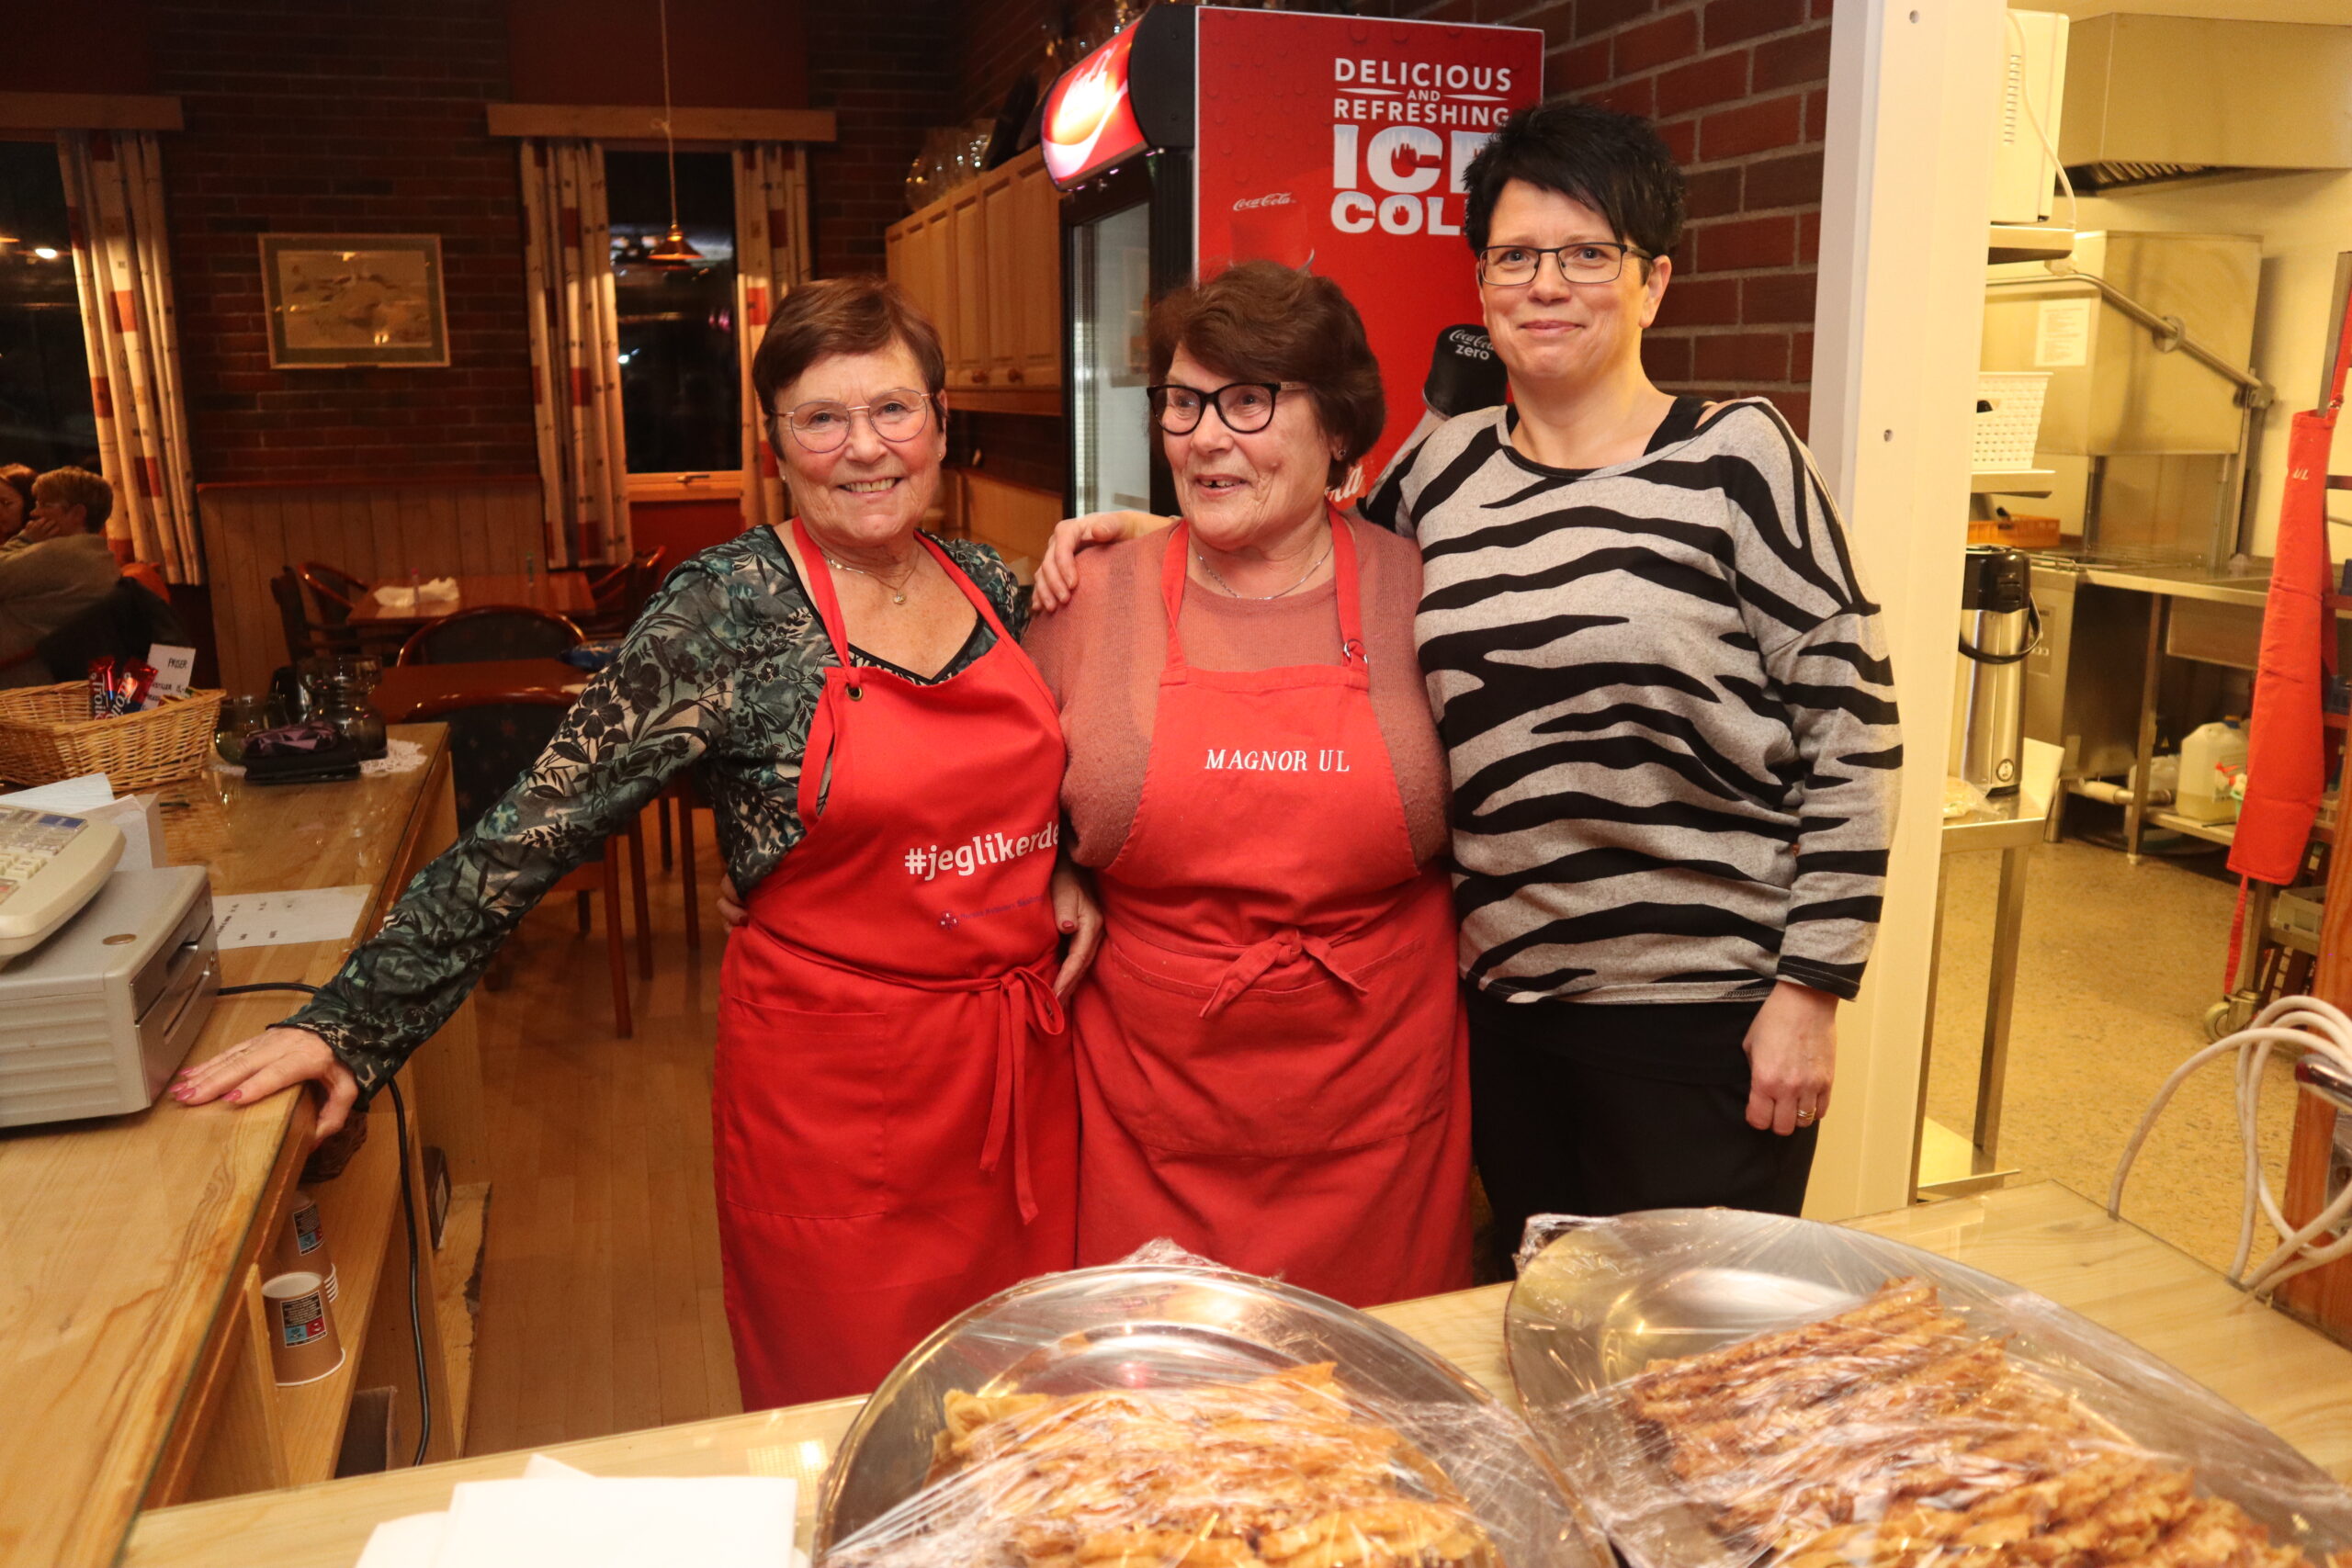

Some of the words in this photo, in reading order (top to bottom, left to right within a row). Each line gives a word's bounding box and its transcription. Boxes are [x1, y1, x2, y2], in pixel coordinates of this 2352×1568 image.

[1335, 58, 1511, 92] DELICIOUS
[1407, 90, 1441, 101] AND
[1333, 98, 1511, 126] REFRESHING
[1330, 191, 1467, 236] COL
[1455, 344, 1489, 360] zero
[1204, 749, 1307, 772] MAGNOR
[1318, 750, 1350, 772] UL
